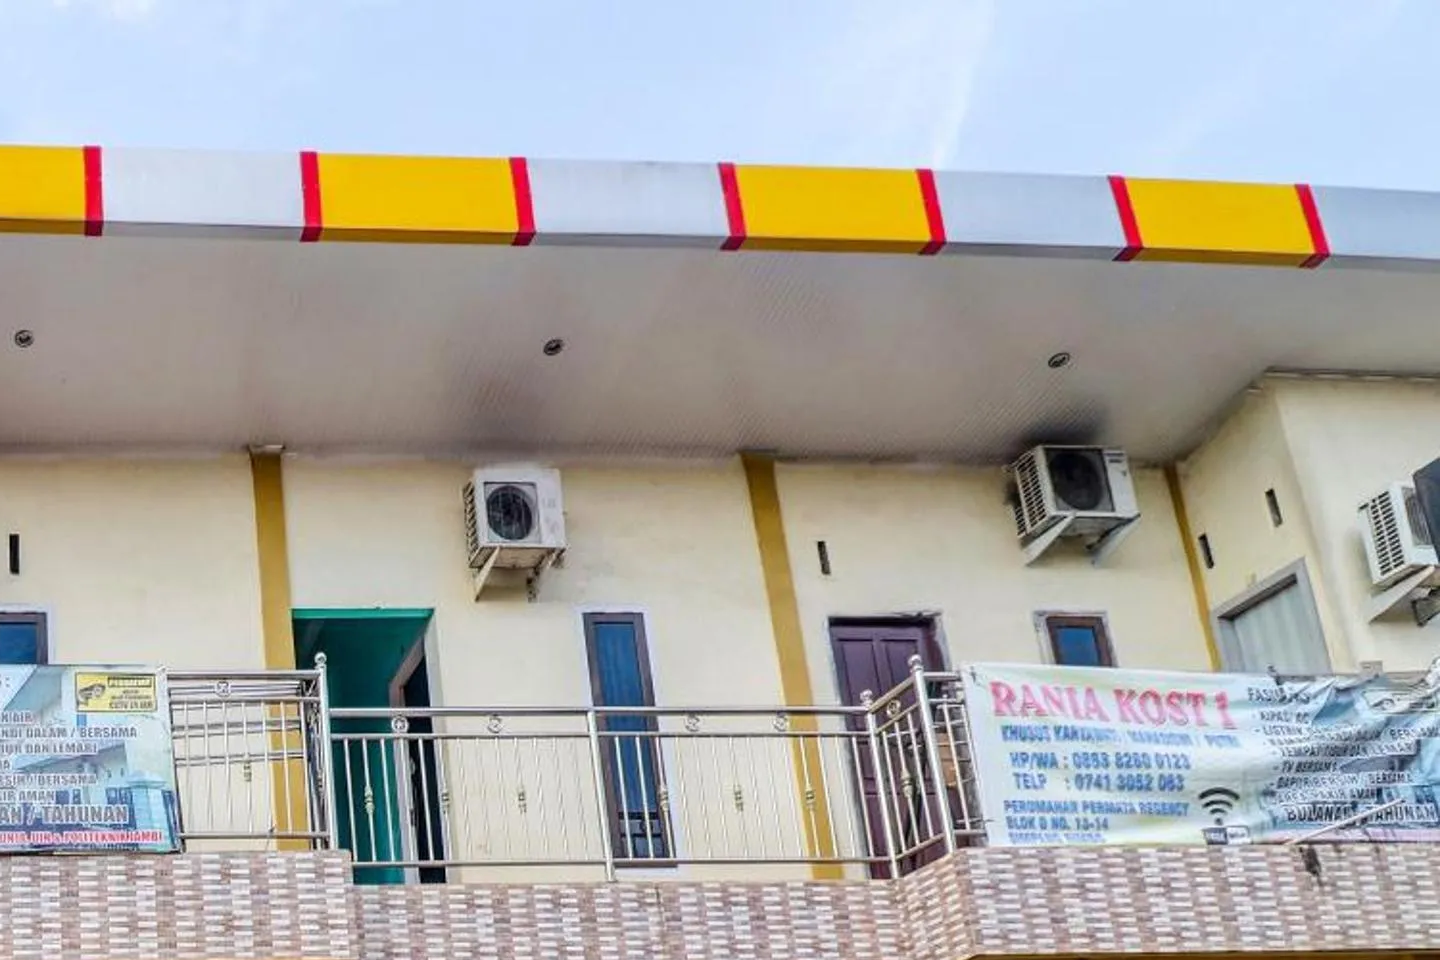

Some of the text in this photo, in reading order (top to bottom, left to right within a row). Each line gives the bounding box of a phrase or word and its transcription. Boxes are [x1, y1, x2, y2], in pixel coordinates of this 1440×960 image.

[989, 681, 1238, 730] RANIA KOST 1
[26, 728, 67, 738] DALAM
[80, 727, 137, 738] BERSAMA
[26, 743, 49, 753] DAN
[1010, 752, 1059, 769] HP/WA
[1155, 752, 1191, 770] 0123
[38, 775, 97, 785] BERSAMA
[1013, 772, 1047, 790] TELP
[1075, 773, 1110, 791] 0741
[19, 790, 55, 801] AMAN
[42, 805, 127, 822] TAHUNAN
